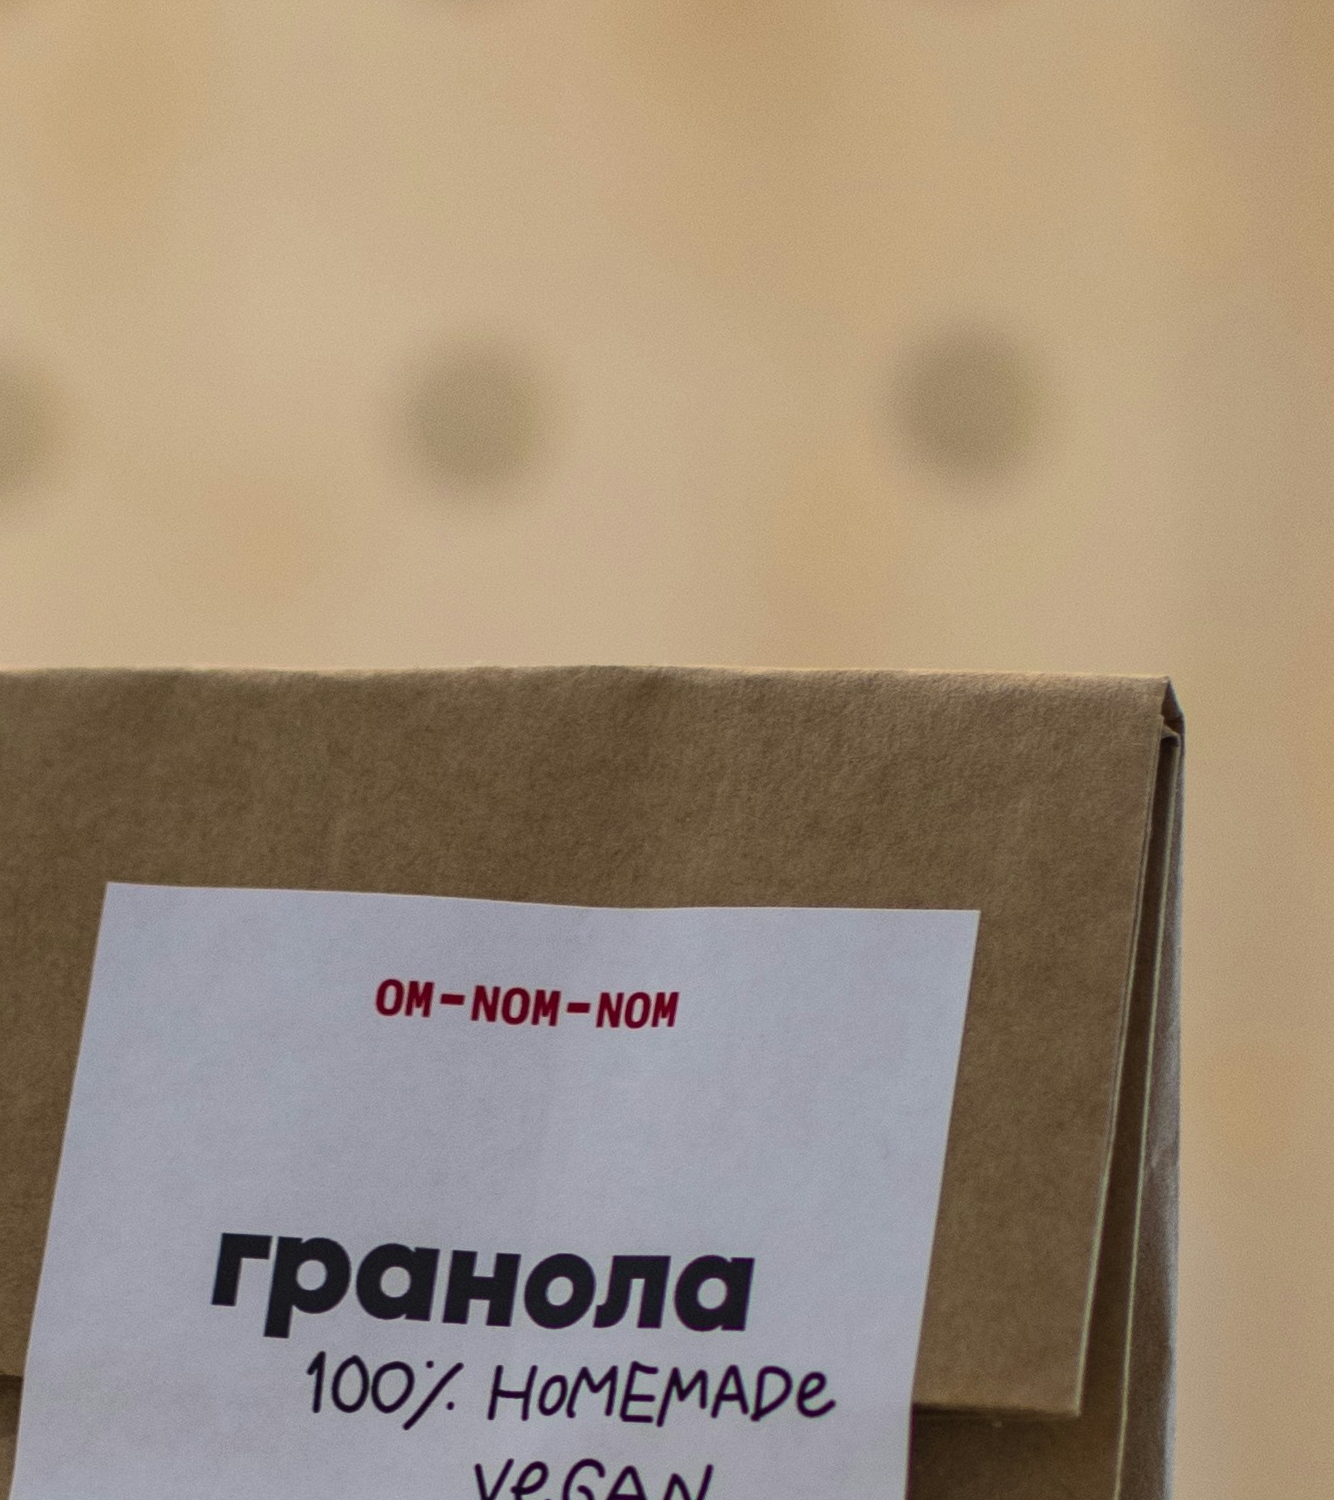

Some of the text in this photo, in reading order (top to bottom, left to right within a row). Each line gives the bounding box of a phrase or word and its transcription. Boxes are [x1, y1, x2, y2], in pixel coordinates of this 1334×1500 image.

[373, 977, 680, 1029] OM-NOM-NOM
[210, 1232, 755, 1339] гранола
[306, 1351, 465, 1431] 100%
